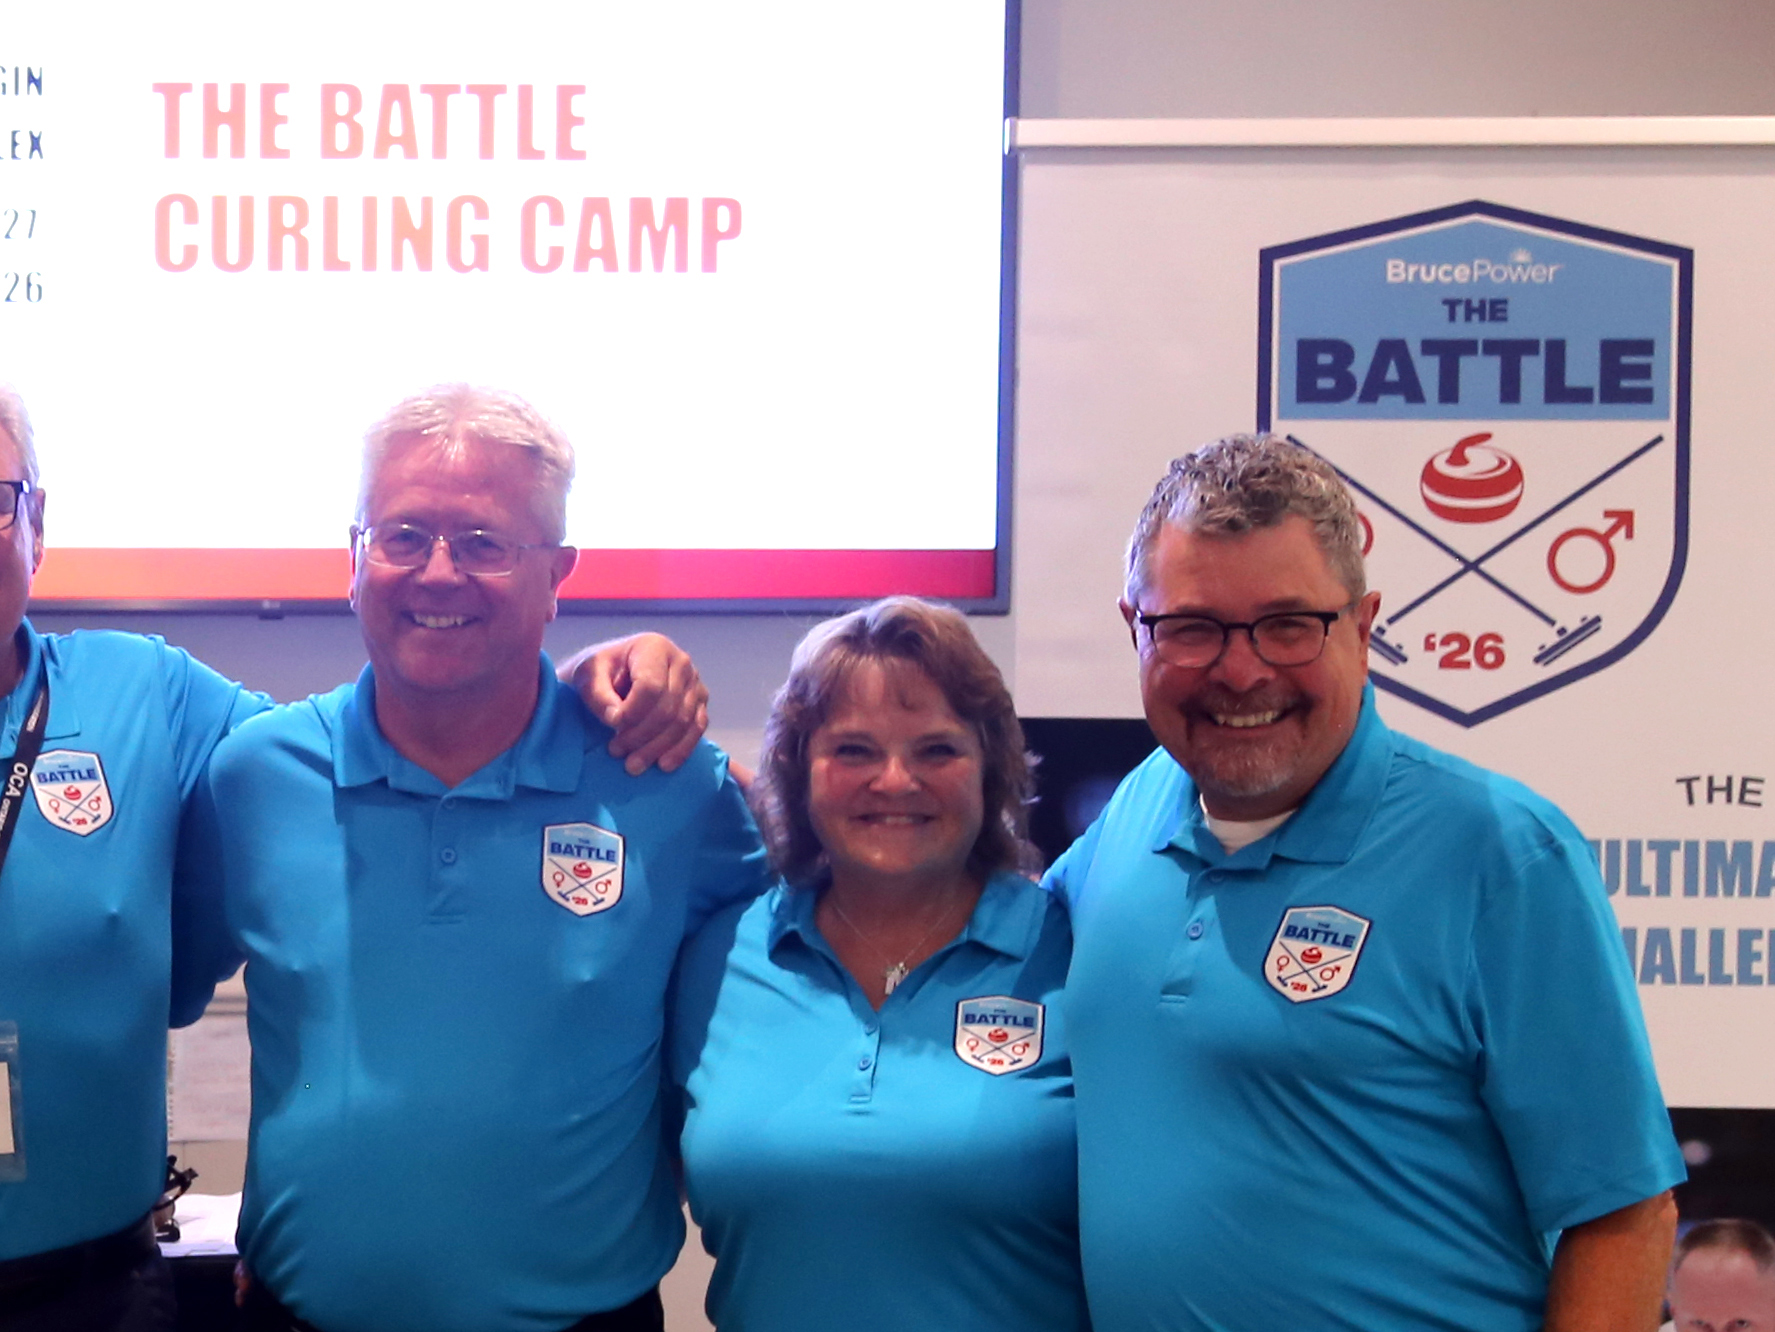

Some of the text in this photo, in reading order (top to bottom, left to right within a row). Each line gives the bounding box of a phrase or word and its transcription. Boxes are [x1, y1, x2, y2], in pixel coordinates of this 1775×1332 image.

[152, 82, 587, 161] THE BATTLE
[3, 208, 39, 239] 27
[154, 193, 742, 274] CURLING CAMP
[1442, 298, 1509, 323] THE
[1295, 338, 1655, 405] BATTLE
[5, 762, 28, 797] OCA
[36, 767, 98, 784] BATTLE
[1675, 775, 1766, 807] THE
[550, 842, 615, 862] BATTLE
[1283, 924, 1356, 949] BATTLE
[1620, 927, 1775, 986] ALLE
[964, 1013, 1034, 1028] BATTLE
